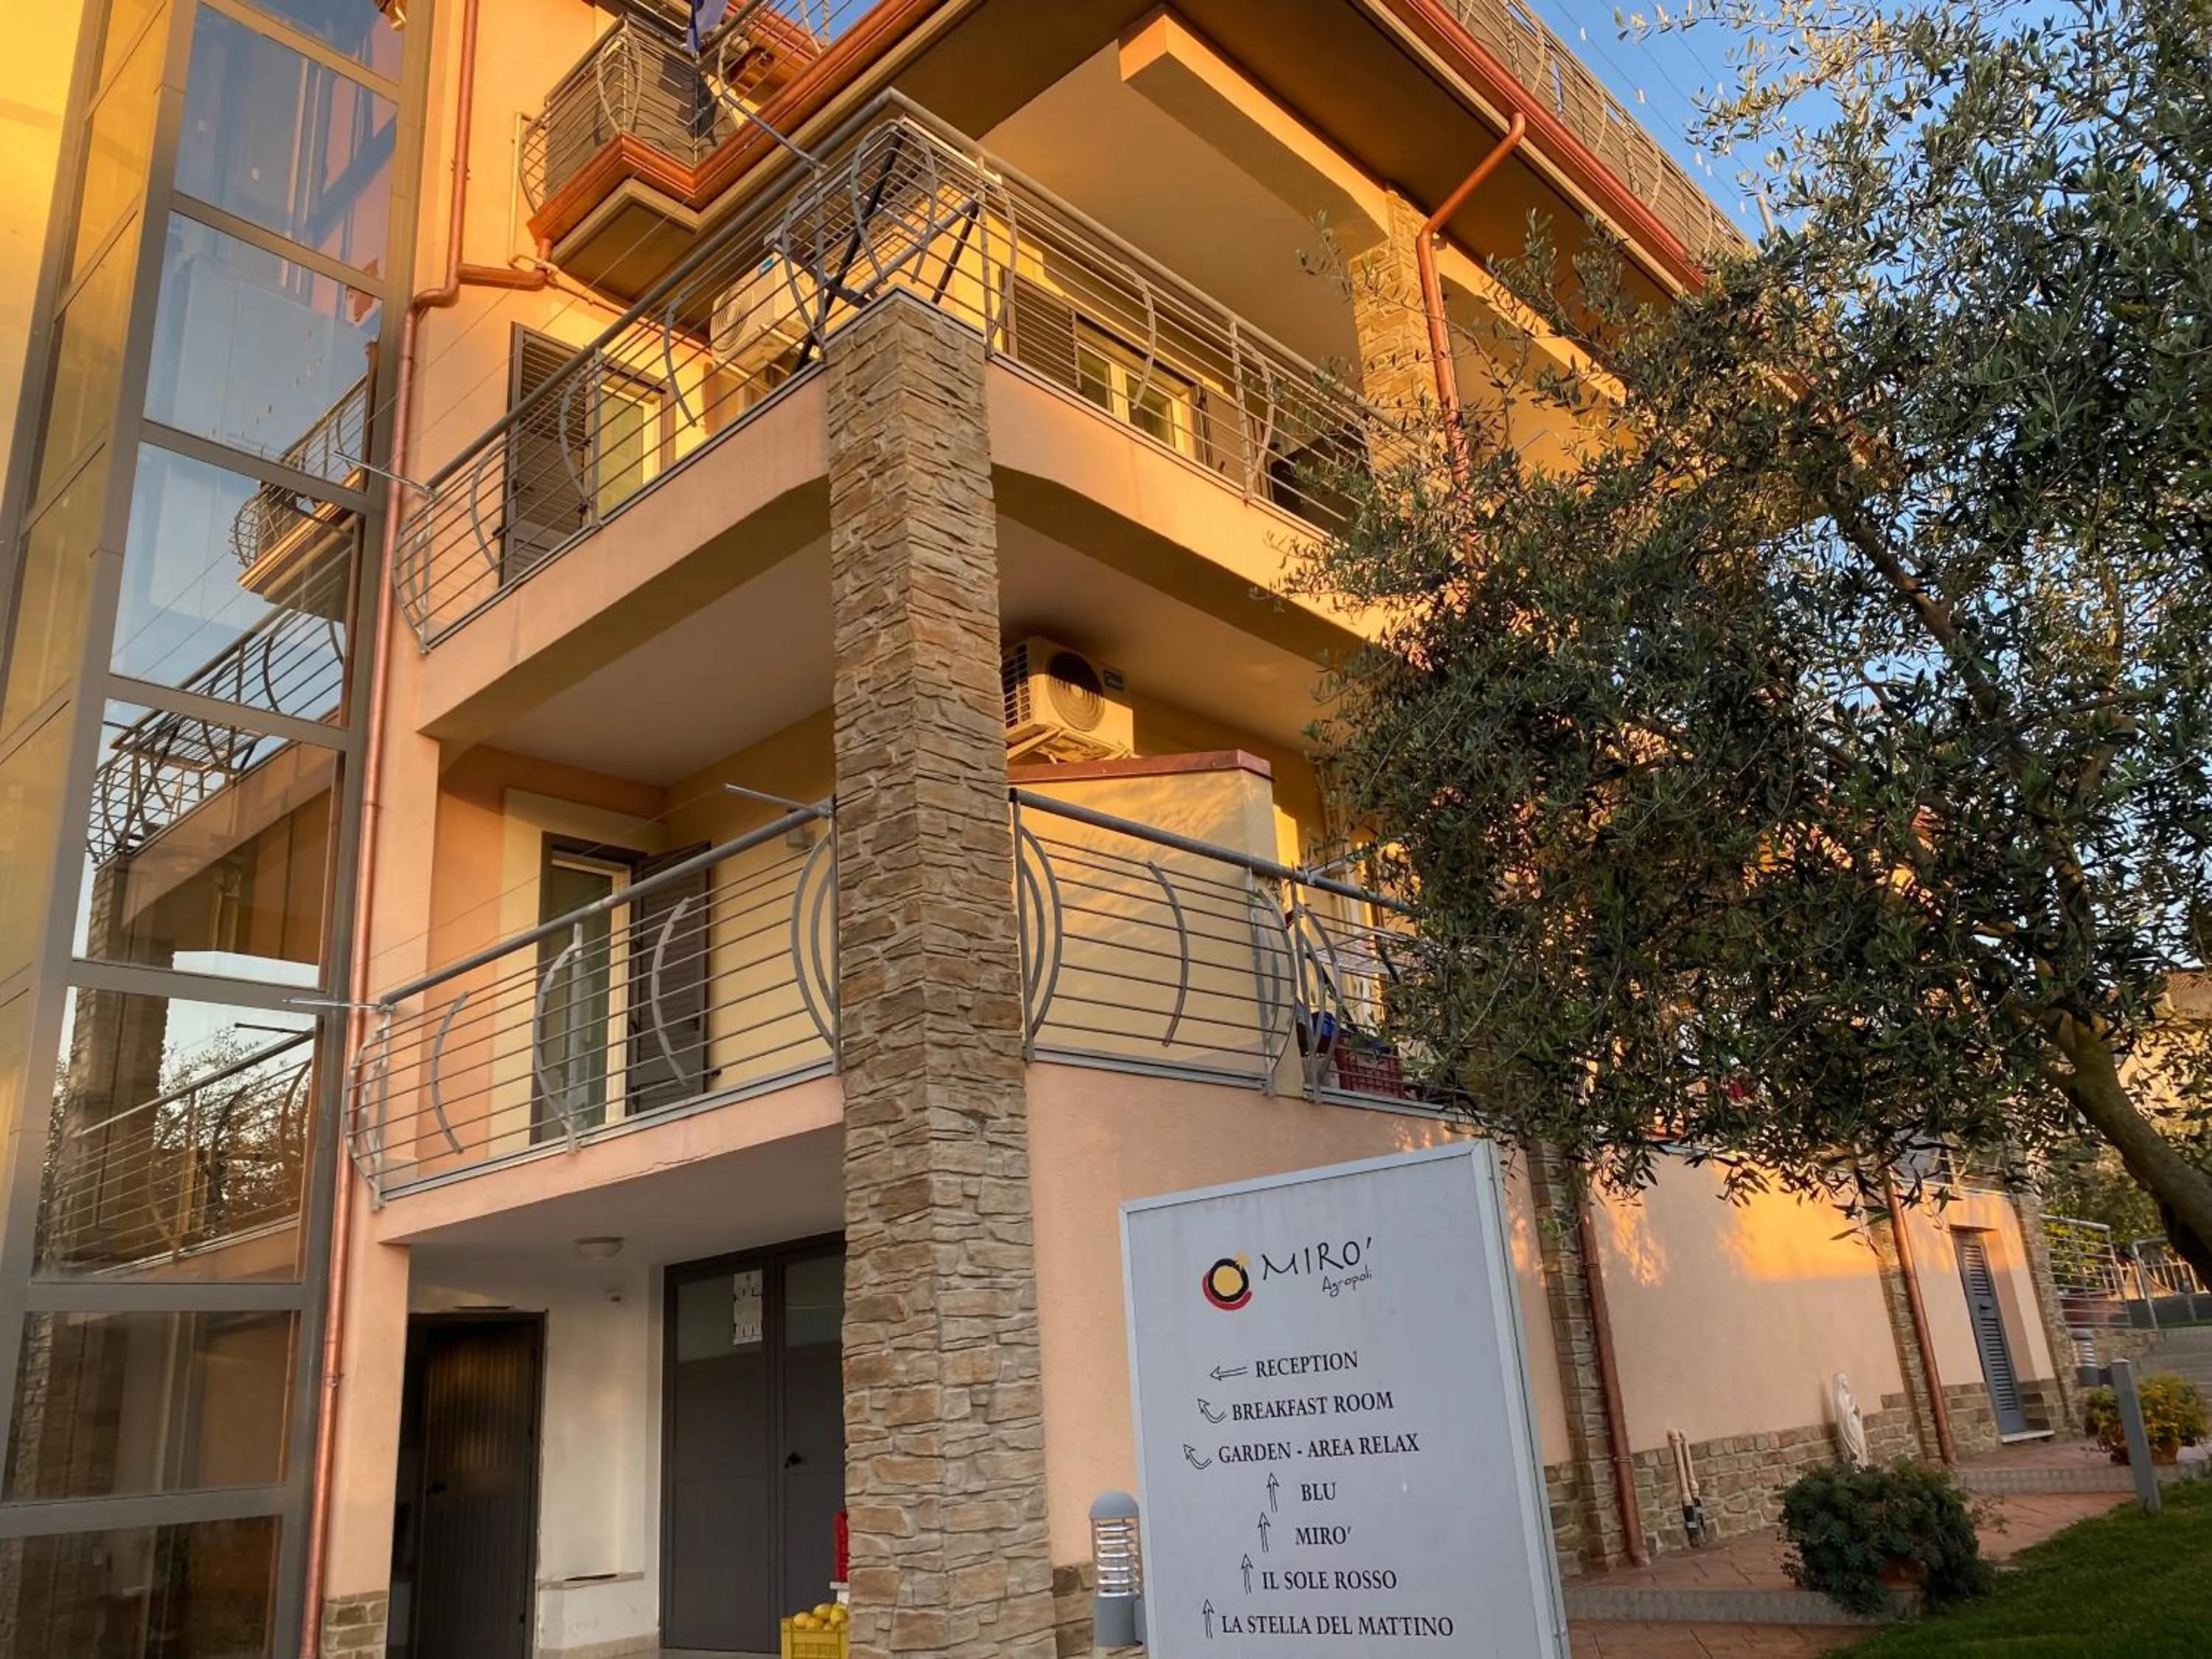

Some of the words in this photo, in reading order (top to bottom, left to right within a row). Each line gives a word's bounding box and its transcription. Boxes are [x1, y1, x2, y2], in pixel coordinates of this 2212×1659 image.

[1262, 1237, 1372, 1281] MIRO'
[1322, 1265, 1372, 1298] Agropoli
[1254, 1350, 1358, 1378] RECEPTION
[1231, 1396, 1328, 1422] BREAKFAST
[1332, 1391, 1395, 1413] ROOM
[1218, 1441, 1291, 1464] GARDEN
[1307, 1438, 1355, 1458] AREA
[1357, 1433, 1420, 1455] RELAX
[1300, 1481, 1337, 1502] BLU
[1295, 1526, 1352, 1546] MIRO'
[1262, 1571, 1280, 1590] IL
[1284, 1571, 1329, 1590] SOLE
[1333, 1569, 1397, 1590] ROSSO
[1221, 1615, 1244, 1633] LA
[1247, 1615, 1313, 1635] STELLA
[1315, 1615, 1353, 1635] DEL
[1357, 1615, 1454, 1637] MATTINO
